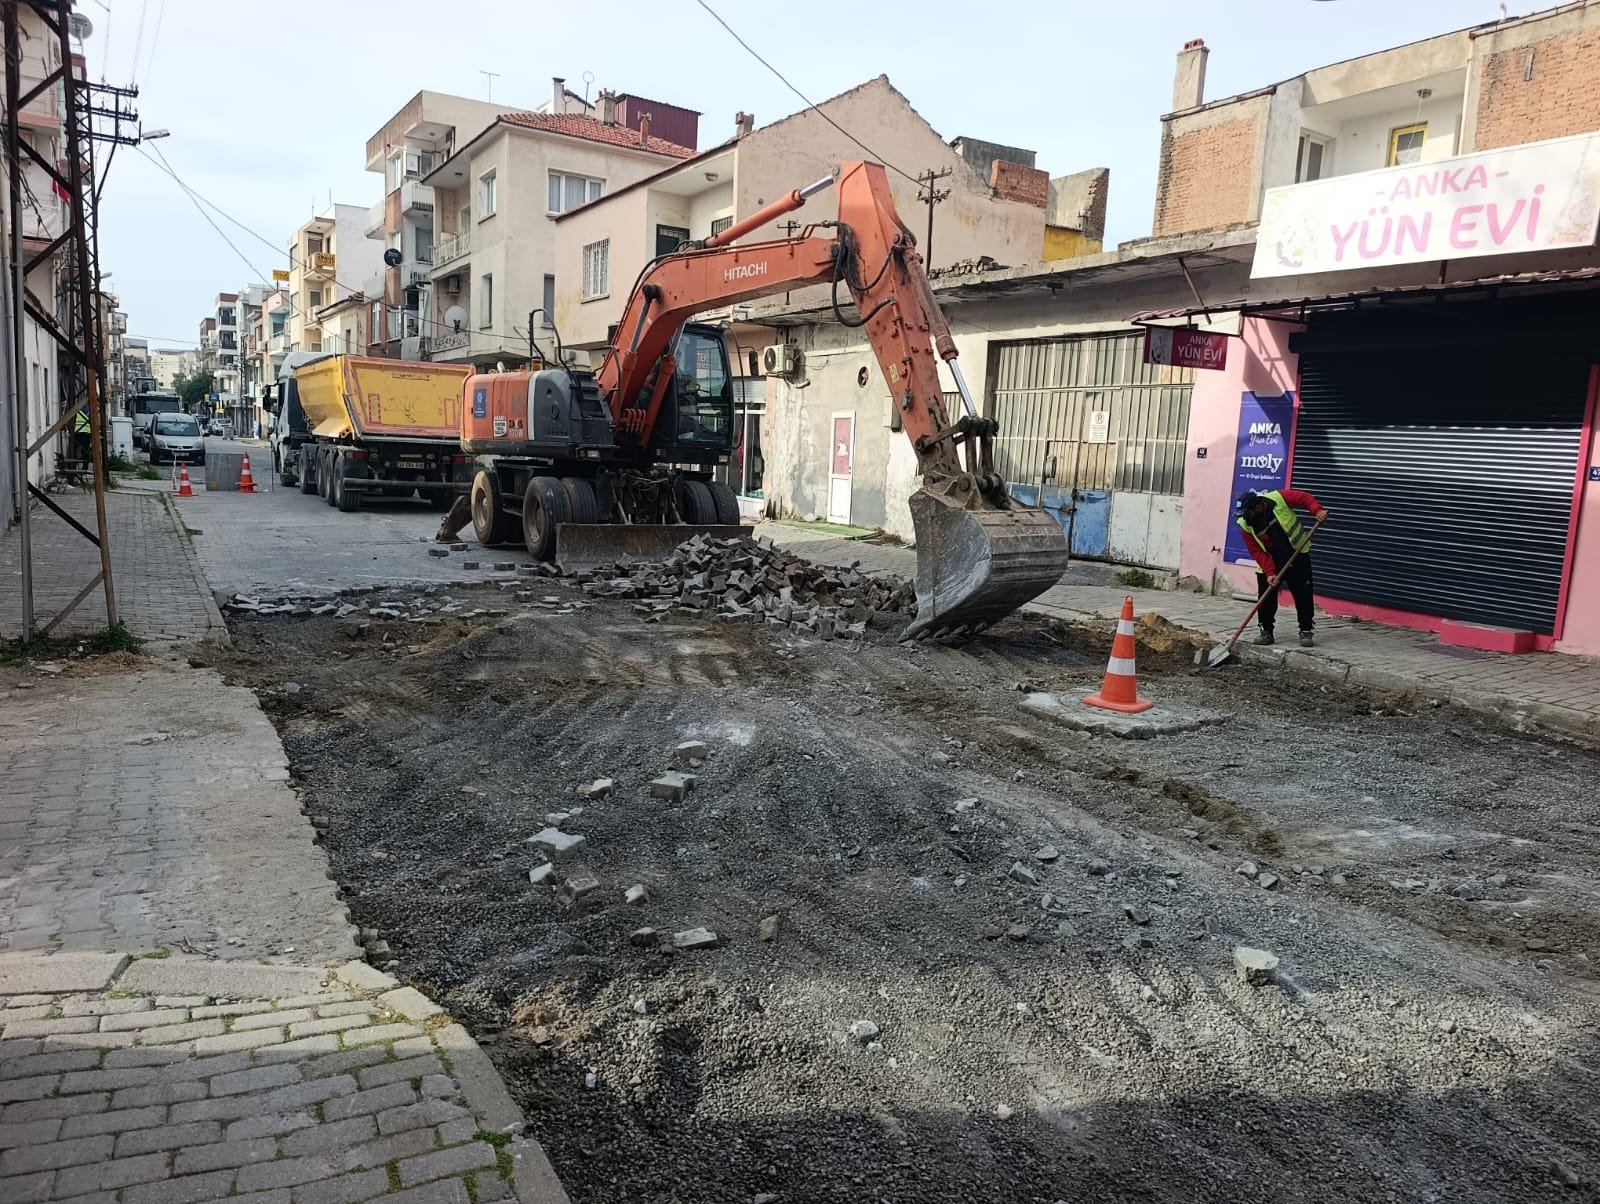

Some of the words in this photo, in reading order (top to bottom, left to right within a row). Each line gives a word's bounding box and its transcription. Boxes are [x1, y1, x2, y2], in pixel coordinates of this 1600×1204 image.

[1330, 206, 1432, 262] YÜN
[1449, 184, 1545, 249] EVİ
[724, 261, 768, 281] HITACHI
[1189, 335, 1212, 346] ANKA
[1177, 344, 1201, 359] YÜN
[1204, 348, 1222, 362] EVİ
[1249, 422, 1282, 434] ANKA
[1240, 453, 1284, 473] moly
